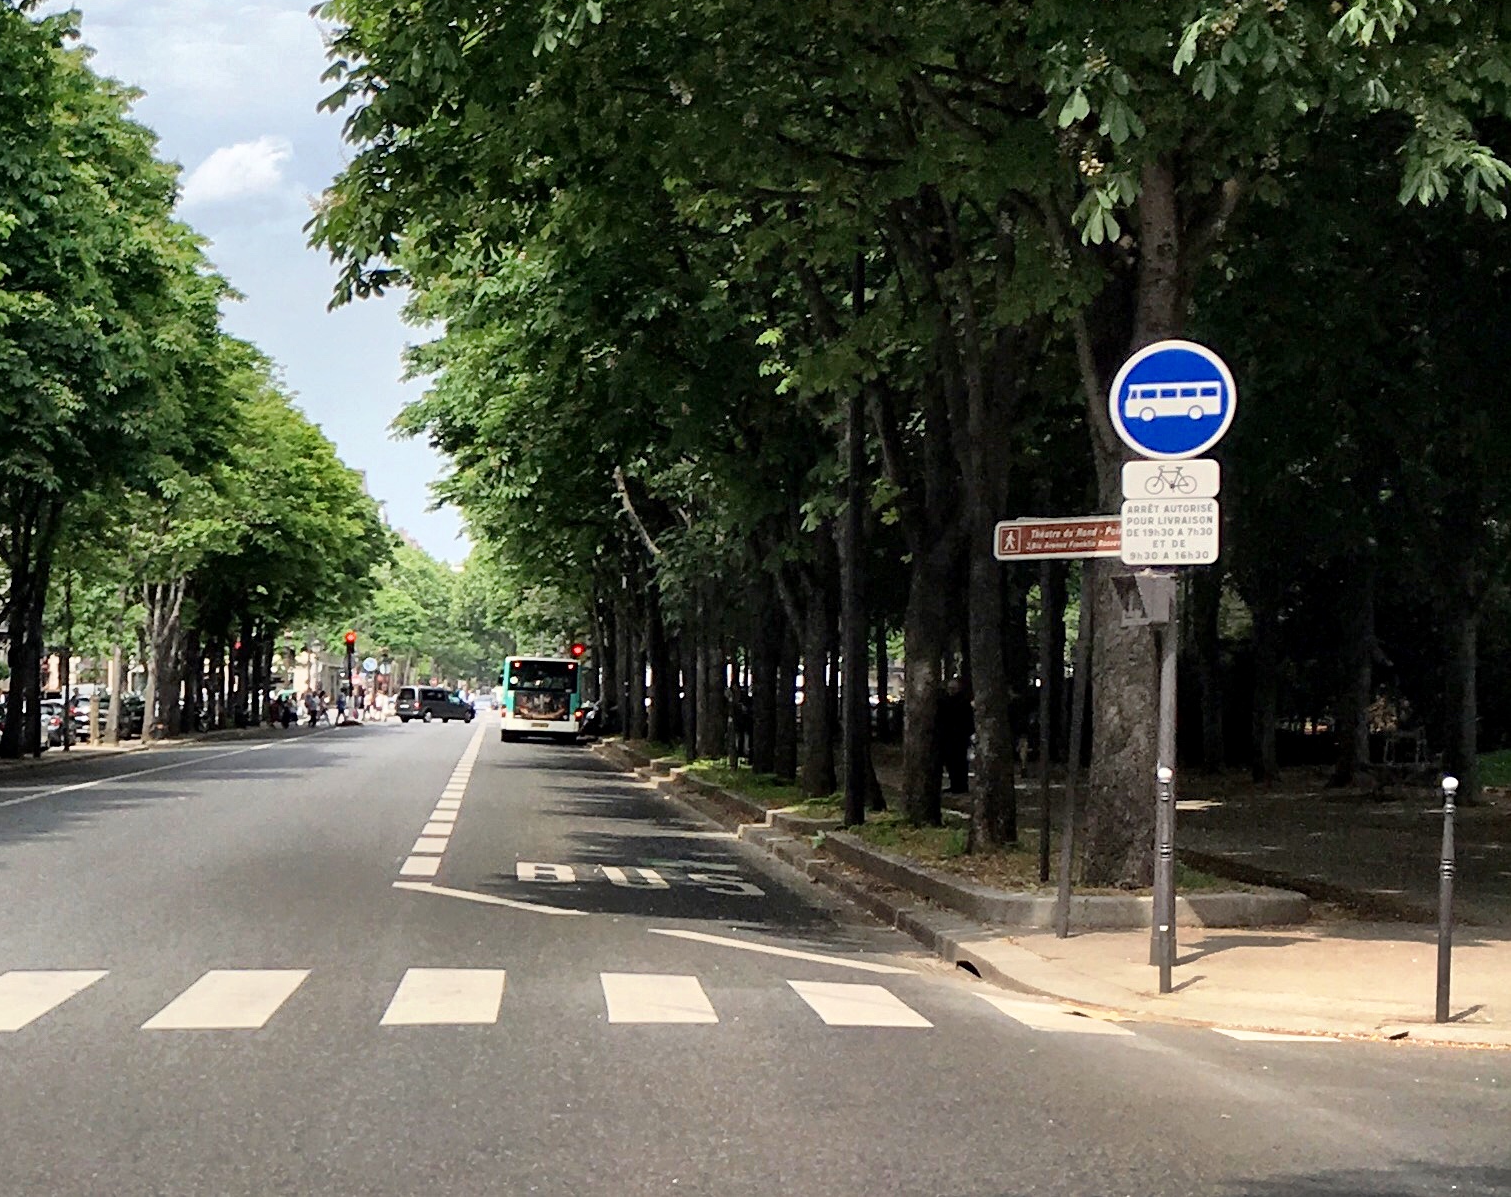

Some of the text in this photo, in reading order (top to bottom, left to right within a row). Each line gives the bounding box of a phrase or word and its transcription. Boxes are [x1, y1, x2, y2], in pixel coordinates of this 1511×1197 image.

[1127, 503, 1213, 513] ARRÊT AUTORISÉ
[1126, 516, 1213, 525] POUR LIVRAISON
[1126, 529, 1139, 537] DE
[1143, 528, 1174, 537] 19h30
[1187, 527, 1213, 536] 7h30
[1152, 539, 1186, 548] ET DE
[1130, 550, 1209, 560] 9h30 A 16h30
[516, 861, 766, 896] BUS
